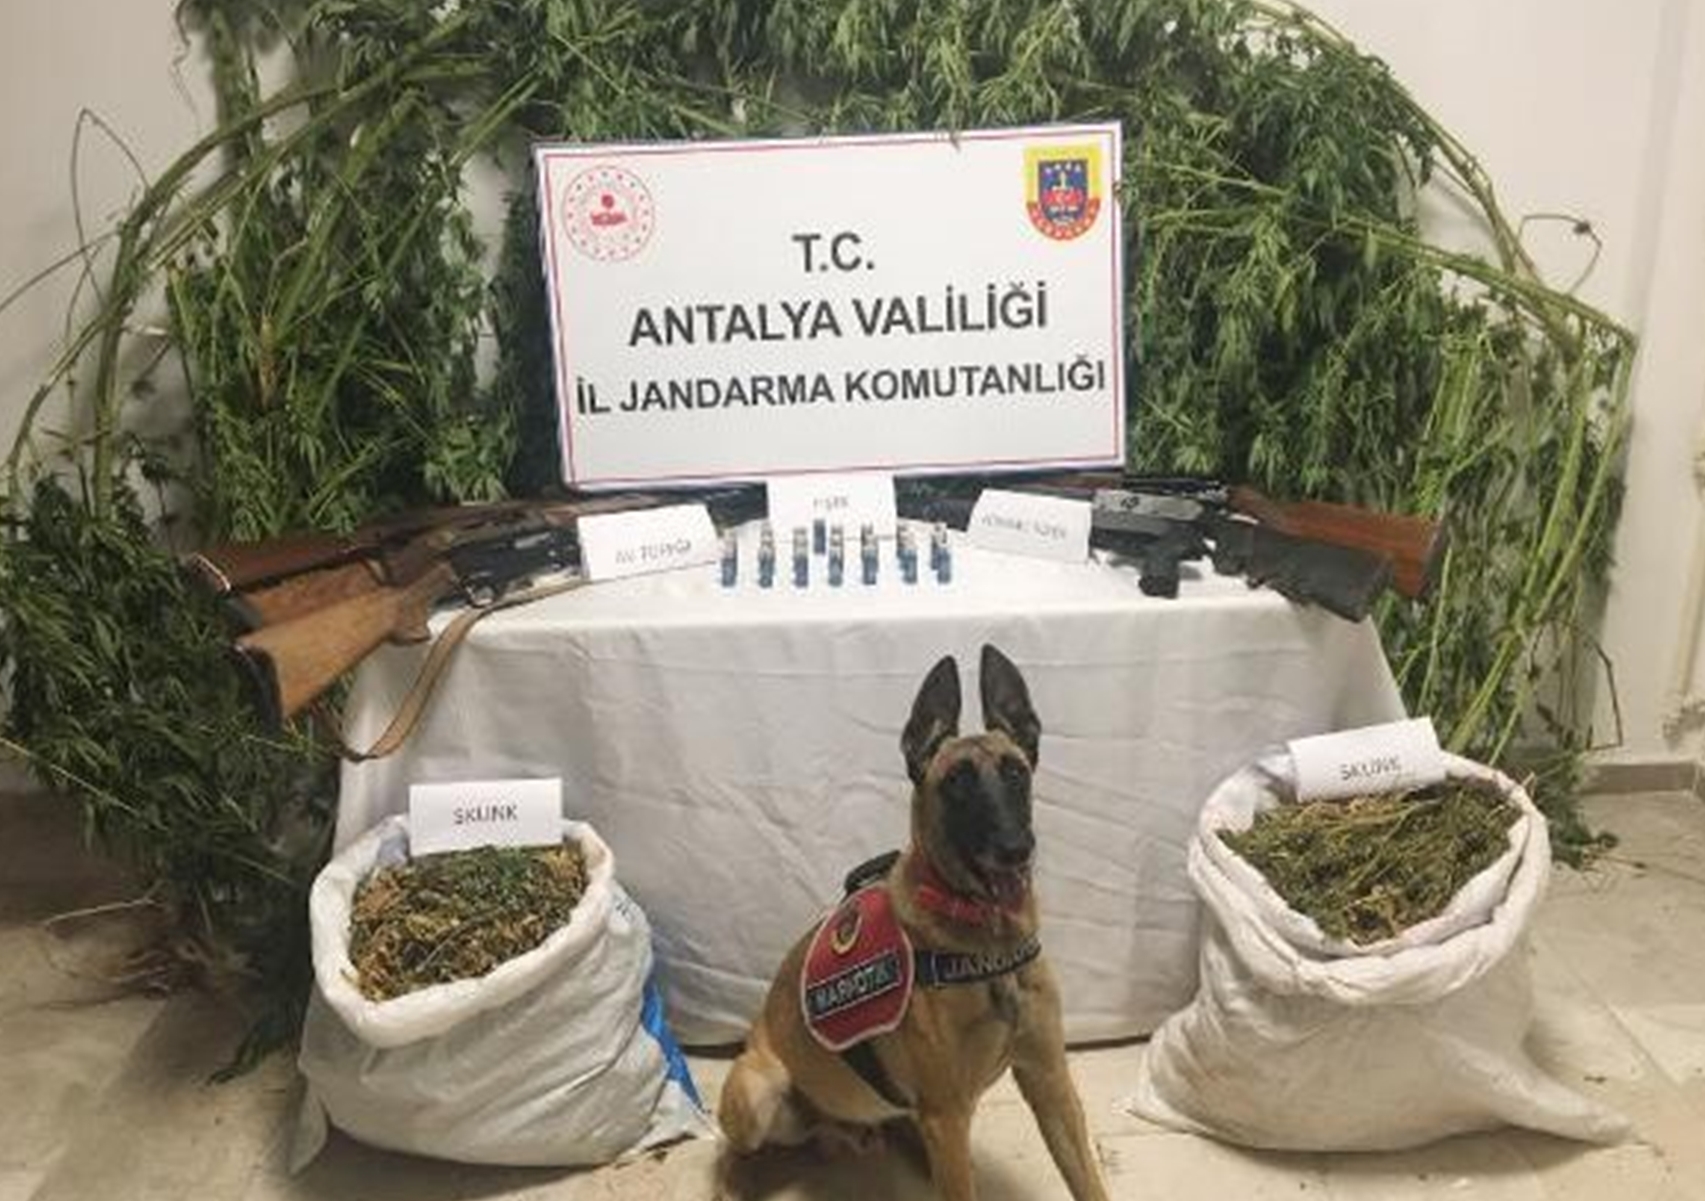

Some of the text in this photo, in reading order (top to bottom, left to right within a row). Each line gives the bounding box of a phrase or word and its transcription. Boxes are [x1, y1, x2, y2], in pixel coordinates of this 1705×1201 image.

[793, 232, 875, 273] T.C.
[628, 281, 1049, 347] ANTALYA VALİLİĞİ
[577, 354, 1106, 414] İL JANDARMA KOMUTANLIĞI
[453, 804, 518, 825] SKUNK
